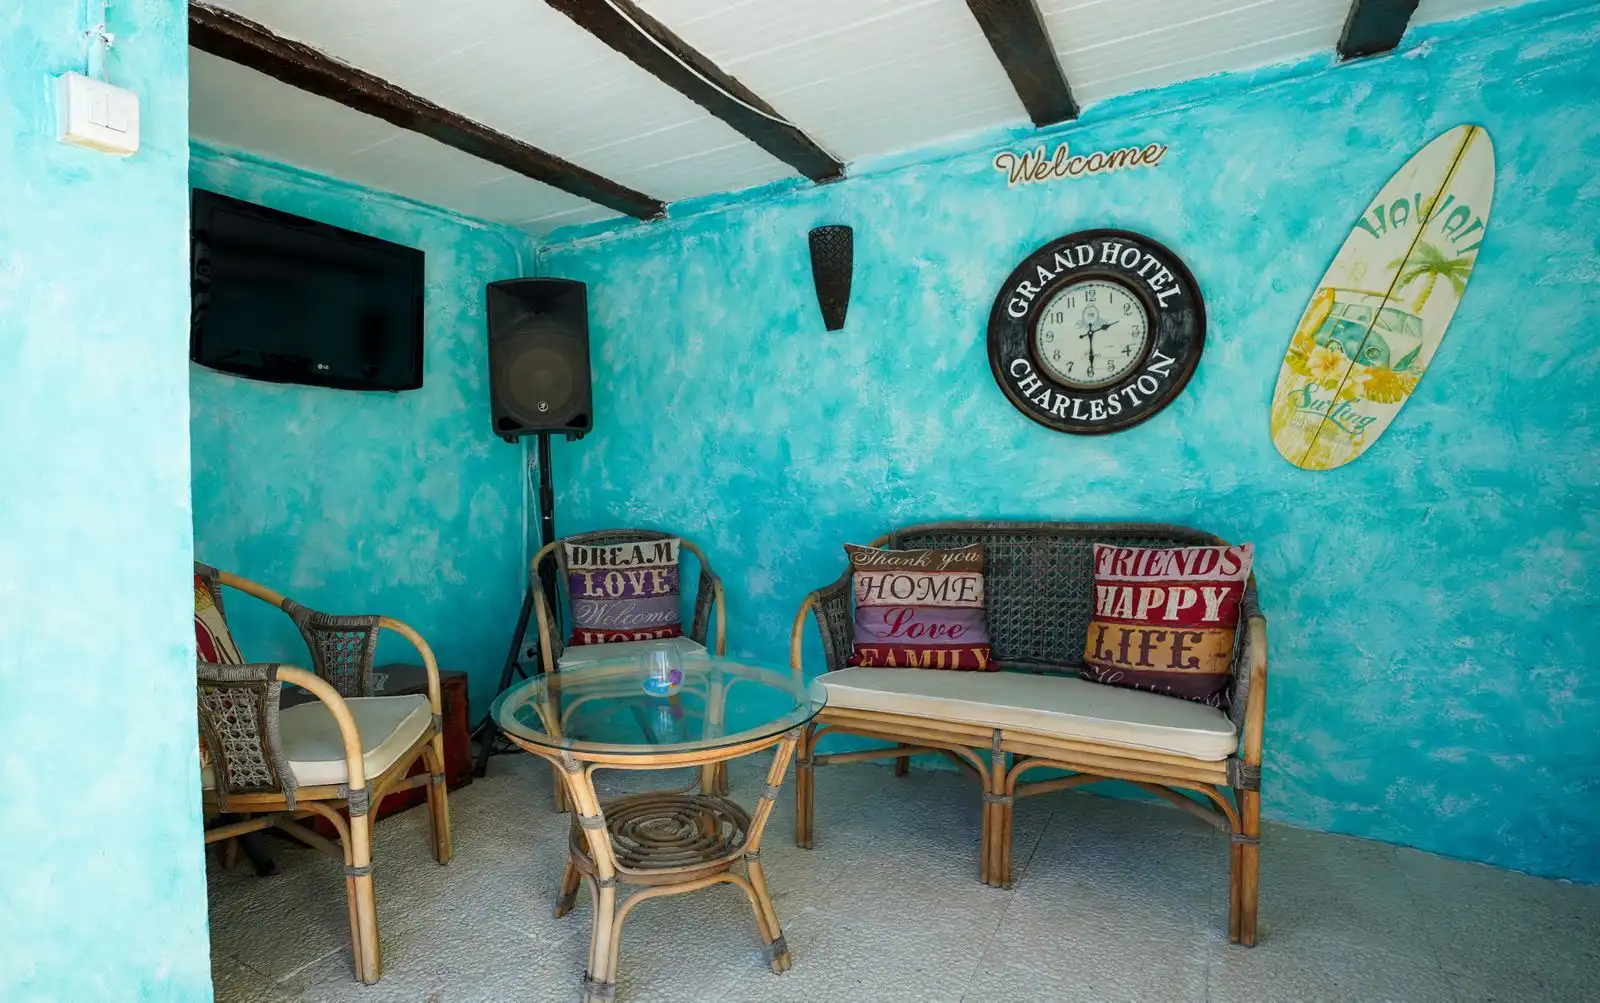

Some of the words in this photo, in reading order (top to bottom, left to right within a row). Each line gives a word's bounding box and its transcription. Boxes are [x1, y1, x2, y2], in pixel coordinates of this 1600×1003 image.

[995, 143, 1169, 185] Welcome
[1007, 244, 1095, 318] GRAND
[1100, 242, 1182, 308] HOTEL
[1067, 296, 1075, 309] 11
[1085, 289, 1097, 302] 12
[1109, 292, 1113, 304] 1
[1050, 311, 1064, 325] 10
[1122, 302, 1133, 316] 2
[1045, 330, 1055, 343] 9
[1131, 324, 1140, 338] 3
[1053, 349, 1061, 361] 8
[1121, 344, 1133, 357] 4
[1066, 361, 1074, 373] 7
[1086, 365, 1095, 378] 6
[1107, 360, 1116, 372] 5
[1010, 349, 1176, 421] CHARLESTON
[1288, 382, 1378, 435] Surfing
[572, 542, 675, 566] DREAM
[850, 548, 932, 568] Thank
[937, 551, 981, 571] you
[1095, 544, 1246, 577] FRIENDS
[583, 569, 671, 597] LOVE
[860, 573, 979, 603] HOME
[575, 600, 678, 626] Welcome
[1096, 585, 1231, 622] HAPPY
[875, 607, 973, 639] Love
[1092, 624, 1204, 670] LIFE
